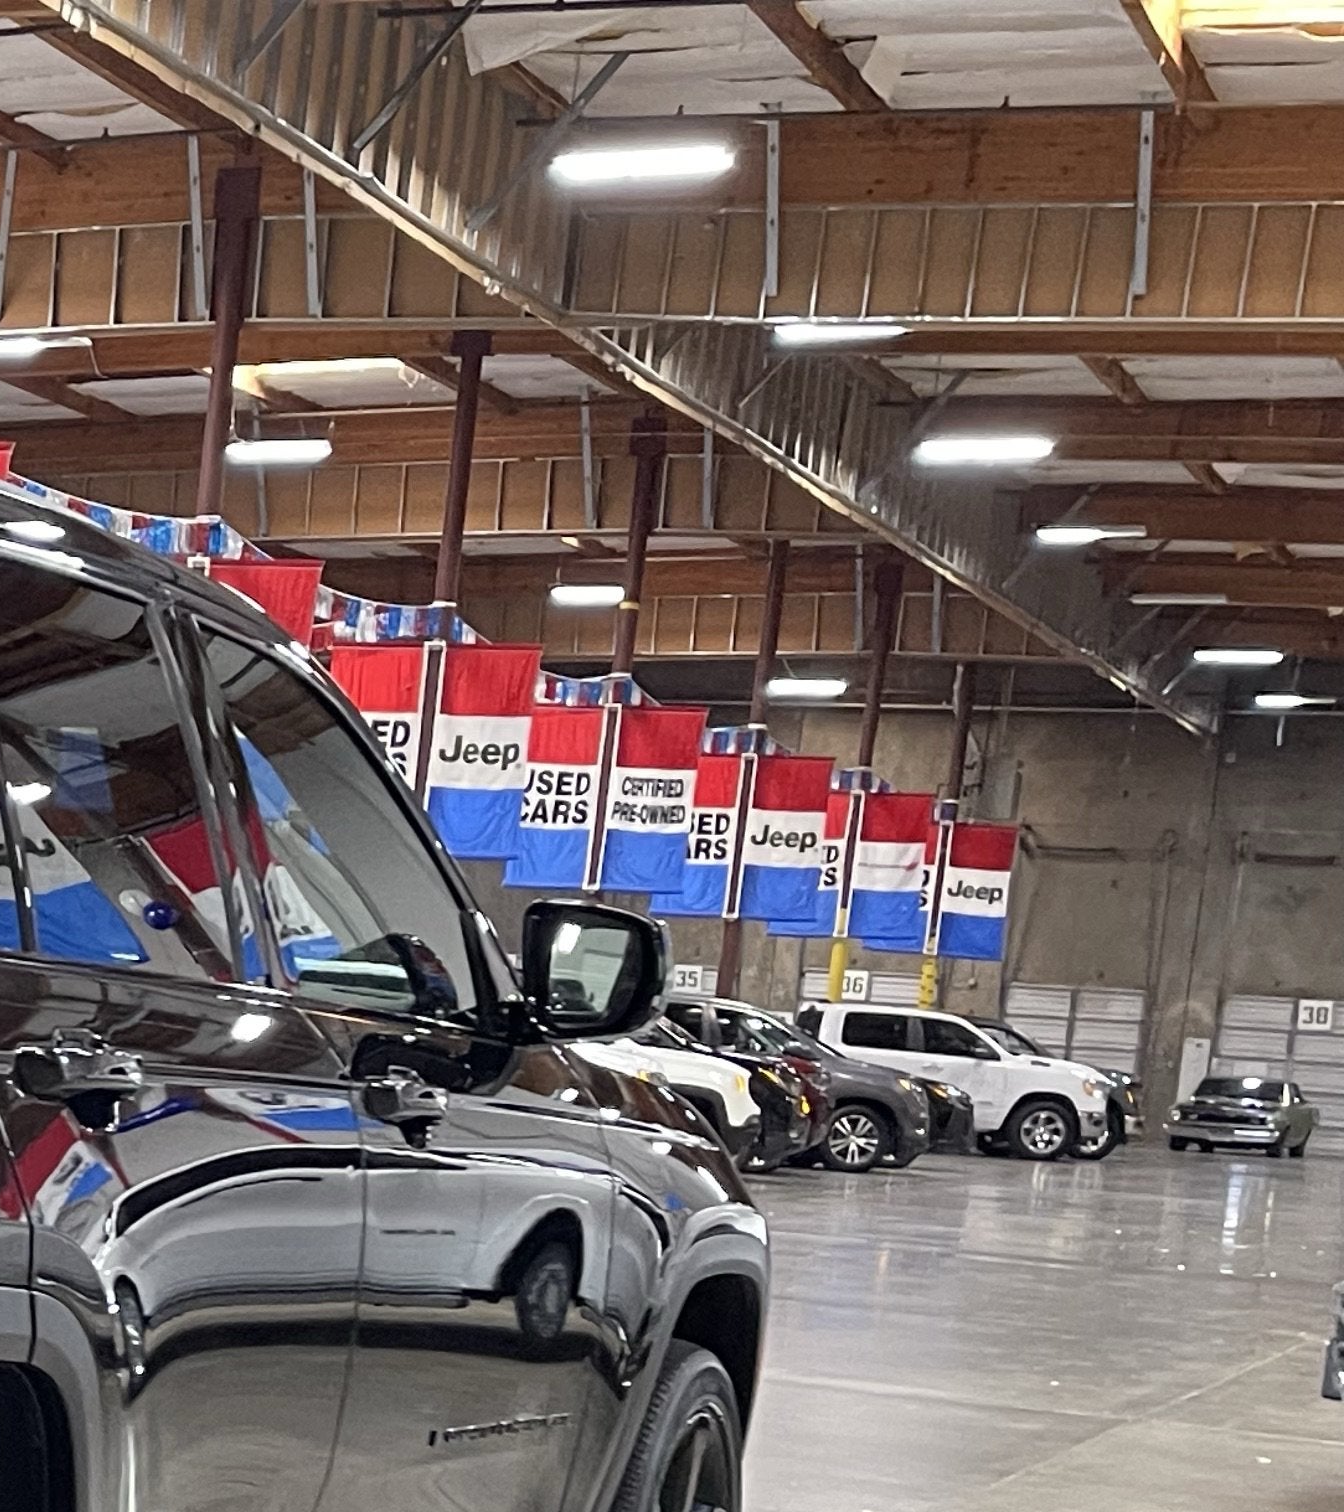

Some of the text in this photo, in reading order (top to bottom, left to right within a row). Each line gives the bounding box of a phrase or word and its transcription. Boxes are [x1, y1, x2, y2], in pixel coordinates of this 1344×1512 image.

[370, 720, 411, 748] ED
[439, 735, 520, 771] Jeep
[621, 776, 684, 798] CERTIFIED
[611, 800, 686, 825] PRE-OWNED
[690, 812, 731, 836] ED
[686, 838, 729, 860] RS
[750, 824, 818, 853] Jeep
[946, 880, 1004, 905] Jeep
[676, 970, 698, 987] 35
